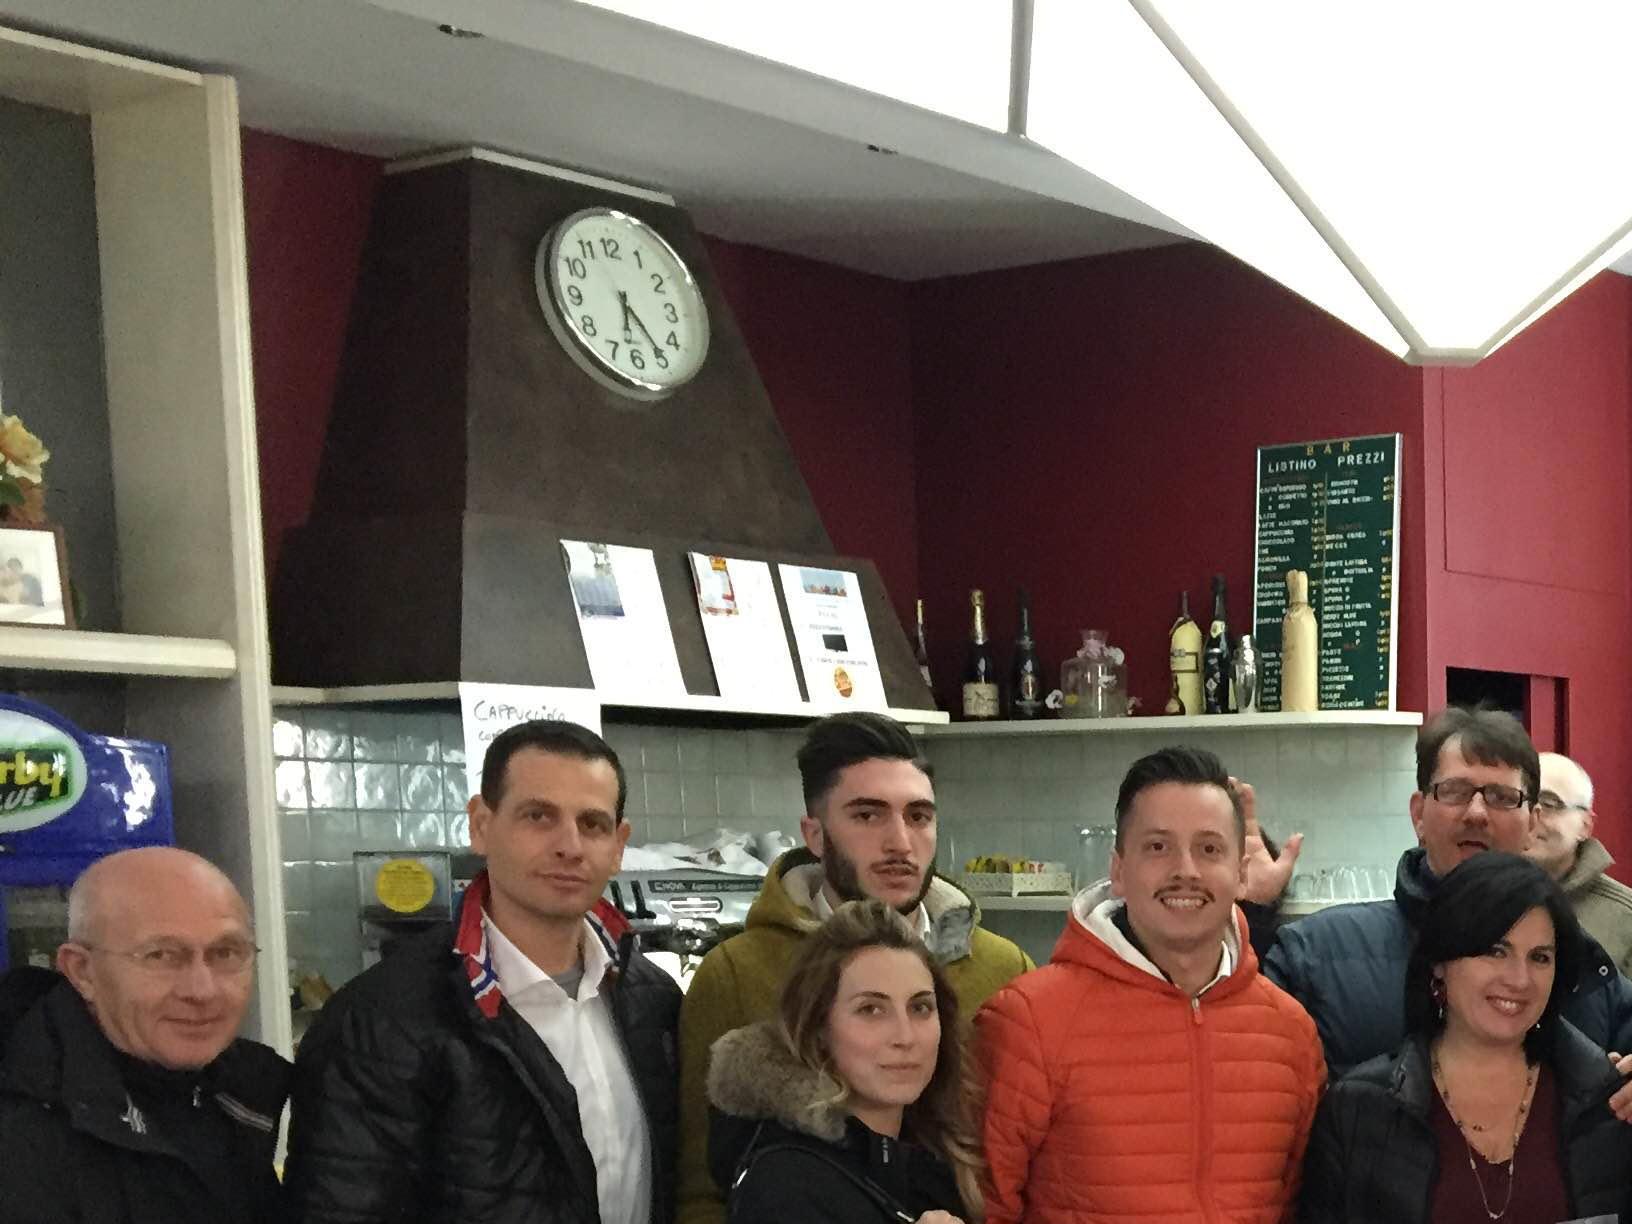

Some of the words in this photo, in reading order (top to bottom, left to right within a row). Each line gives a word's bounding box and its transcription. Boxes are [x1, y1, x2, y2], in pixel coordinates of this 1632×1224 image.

[577, 239, 595, 261] 11
[600, 238, 622, 261] 12
[633, 250, 643, 269] 1
[564, 257, 587, 279] 10
[566, 284, 583, 306] 9
[650, 273, 666, 295] 2
[663, 303, 679, 324] 3
[580, 315, 597, 337] 8
[604, 340, 620, 361] 7
[665, 331, 681, 351] 4
[629, 349, 646, 370] 6
[1268, 459, 1317, 473] LISTINO
[1337, 451, 1385, 467] PREZZI
